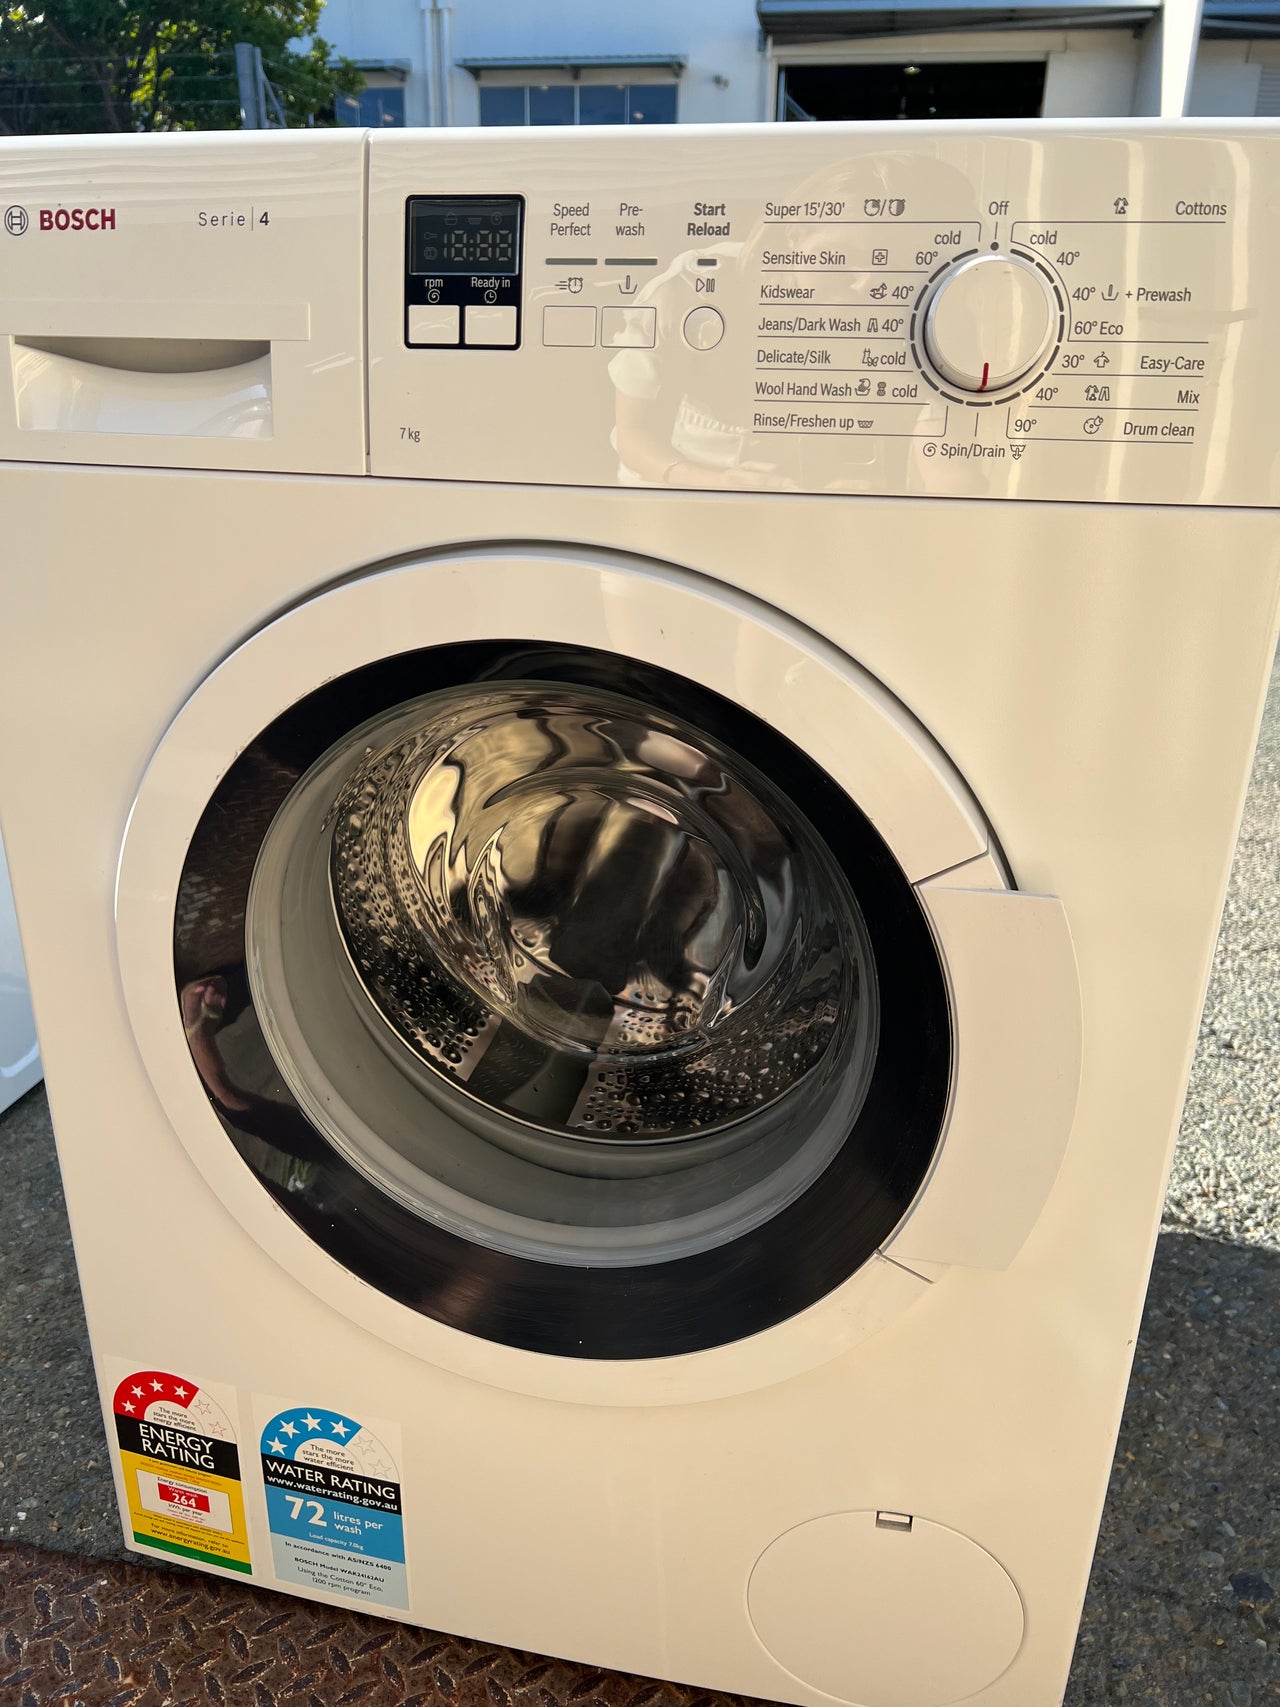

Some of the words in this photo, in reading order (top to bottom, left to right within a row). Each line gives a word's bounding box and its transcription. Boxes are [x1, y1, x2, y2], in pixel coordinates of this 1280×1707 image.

[553, 203, 590, 219] Speed
[619, 203, 643, 217] Pre-
[693, 203, 726, 216] Start
[765, 202, 801, 219] Super
[804, 201, 845, 218] 15'/30'
[988, 200, 1009, 216] Off
[1175, 200, 1228, 216] Cottons
[39, 208, 116, 231] BOSCH
[198, 211, 246, 226] Serie
[259, 211, 270, 226] 4
[550, 222, 592, 236] Perfect
[615, 222, 645, 236] wash
[687, 222, 730, 236] Reload
[934, 230, 961, 245] cold
[1029, 230, 1058, 245] cold
[762, 250, 817, 265] Sensitive
[819, 250, 846, 265] Skin
[915, 251, 939, 265] 60°
[1056, 251, 1080, 266] 40°
[424, 278, 444, 289] rpm
[471, 276, 500, 290] Ready
[502, 276, 511, 288] in
[760, 285, 815, 299] Kidswear
[891, 285, 915, 300] 40°
[1072, 286, 1096, 301] 40°
[1136, 287, 1192, 302] Prewash
[758, 317, 826, 332] Jeans/Dark
[829, 318, 861, 332] Wash
[881, 318, 904, 332] 40°
[1074, 321, 1098, 335] 60°
[1099, 321, 1124, 336] Eco
[757, 349, 831, 365] Delicate/Silk
[880, 351, 906, 366] cold
[1062, 354, 1085, 369] 30°
[1139, 355, 1205, 372] Easy-Care
[755, 381, 784, 395] Wool
[786, 382, 817, 396] Hand
[820, 382, 852, 397] Wash
[891, 384, 918, 398] cold
[1035, 386, 1059, 401] 40°
[1177, 390, 1200, 404] Mix
[753, 412, 837, 428] Rinse/Freshen
[839, 416, 854, 430] up
[1014, 418, 1037, 433] 90°
[1123, 421, 1158, 436] Drum
[1160, 422, 1195, 437] clean
[399, 427, 406, 440] 7
[408, 427, 421, 443] kg
[940, 443, 1006, 459] Spin/Drain
[153, 1411, 167, 1419] stars
[179, 1418, 195, 1426] more
[158, 1406, 171, 1414] The
[171, 1411, 188, 1419] more
[138, 1423, 214, 1454] ENERGY
[141, 1438, 215, 1470] RATING
[302, 1450, 319, 1458] stars
[321, 1453, 333, 1461] the
[335, 1457, 355, 1466] more
[310, 1443, 325, 1453] The
[325, 1449, 346, 1458] more
[303, 1456, 324, 1465] water
[326, 1460, 354, 1472] efficient
[266, 1459, 326, 1485] WATER
[330, 1474, 396, 1500] RATING
[172, 1492, 197, 1508] 264
[266, 1475, 398, 1511] www.waterrating.gov.au
[284, 1494, 328, 1527] 72
[333, 1510, 361, 1525] litres
[364, 1520, 384, 1530] per
[334, 1522, 362, 1536] wash
[293, 1544, 330, 1557] accordance
[331, 1552, 346, 1561] with
[294, 1556, 319, 1567] BOSCH
[319, 1563, 339, 1572] Model
[297, 1566, 316, 1577] Using
[317, 1571, 328, 1579] the
[329, 1574, 354, 1585] Cotton
[312, 1576, 327, 1585] 1200
[327, 1581, 342, 1590] rpm
[343, 1585, 371, 1597] program
